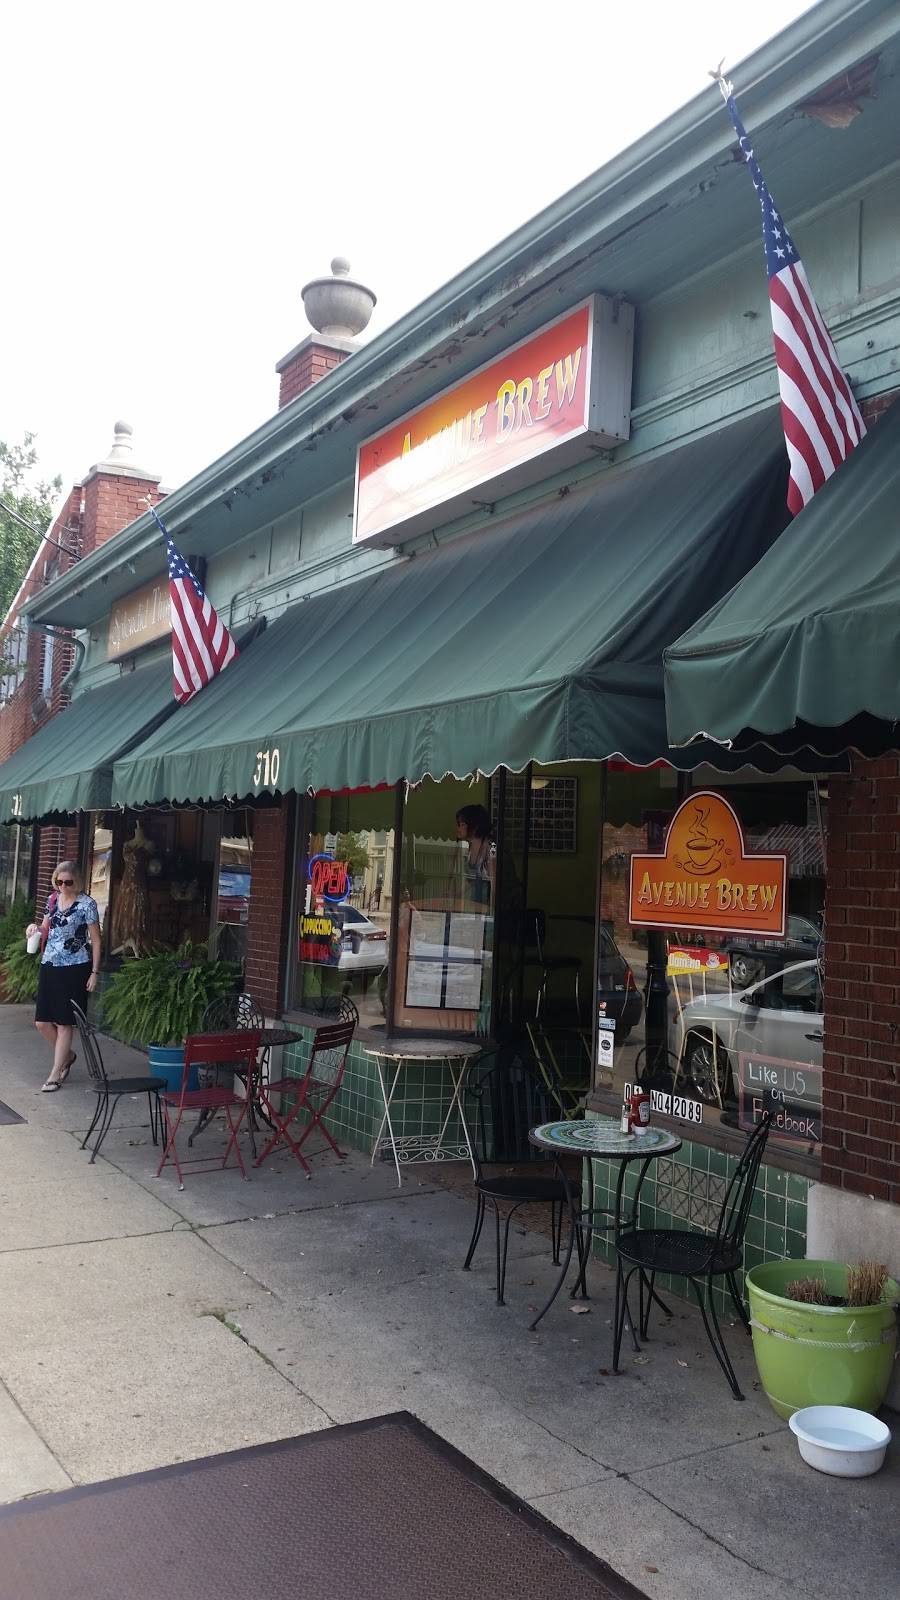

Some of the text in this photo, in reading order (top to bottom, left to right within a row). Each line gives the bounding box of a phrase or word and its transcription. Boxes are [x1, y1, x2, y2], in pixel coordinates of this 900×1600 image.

[495, 346, 582, 443] BREW
[253, 748, 280, 787] 310
[311, 859, 350, 898] OPEN
[638, 871, 778, 912] AVENUE BREW
[300, 914, 332, 938] CAPPUCCINO
[748, 1062, 778, 1085] Like
[771, 1087, 786, 1103] on
